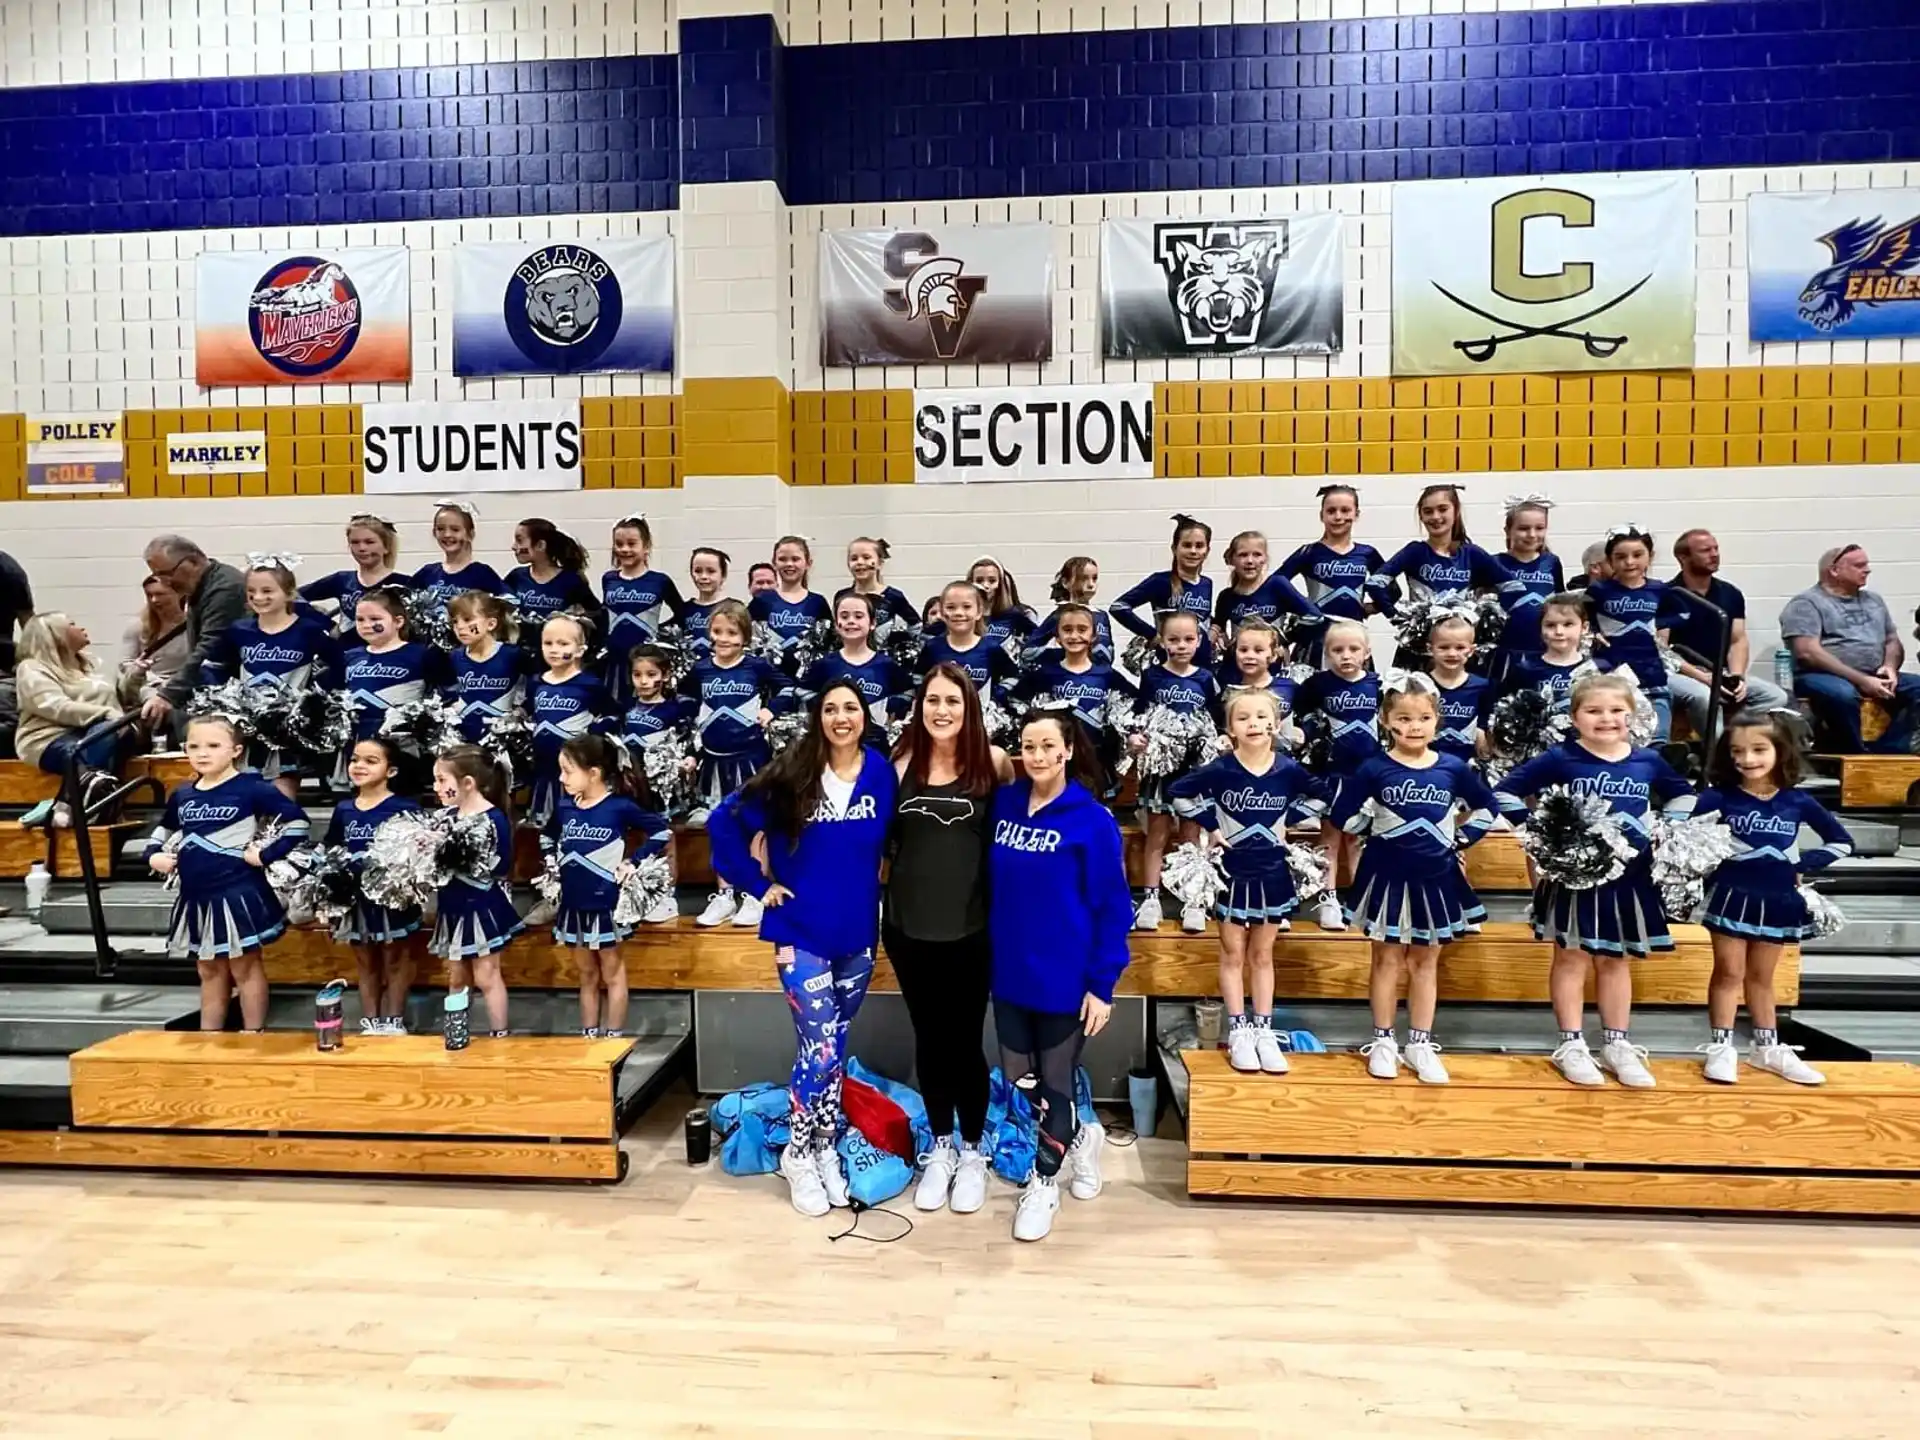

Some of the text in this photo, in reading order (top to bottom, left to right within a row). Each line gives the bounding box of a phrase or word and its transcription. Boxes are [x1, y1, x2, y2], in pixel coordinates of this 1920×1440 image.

[517, 246, 608, 284] BEARS
[1491, 187, 1596, 305] C
[261, 298, 357, 350] MAVERICKS
[41, 422, 117, 441] POLLEY
[169, 445, 261, 463] MARKLEY
[364, 420, 579, 474] STUDENTS
[914, 399, 1154, 469] SECTION
[45, 464, 97, 484] COLE
